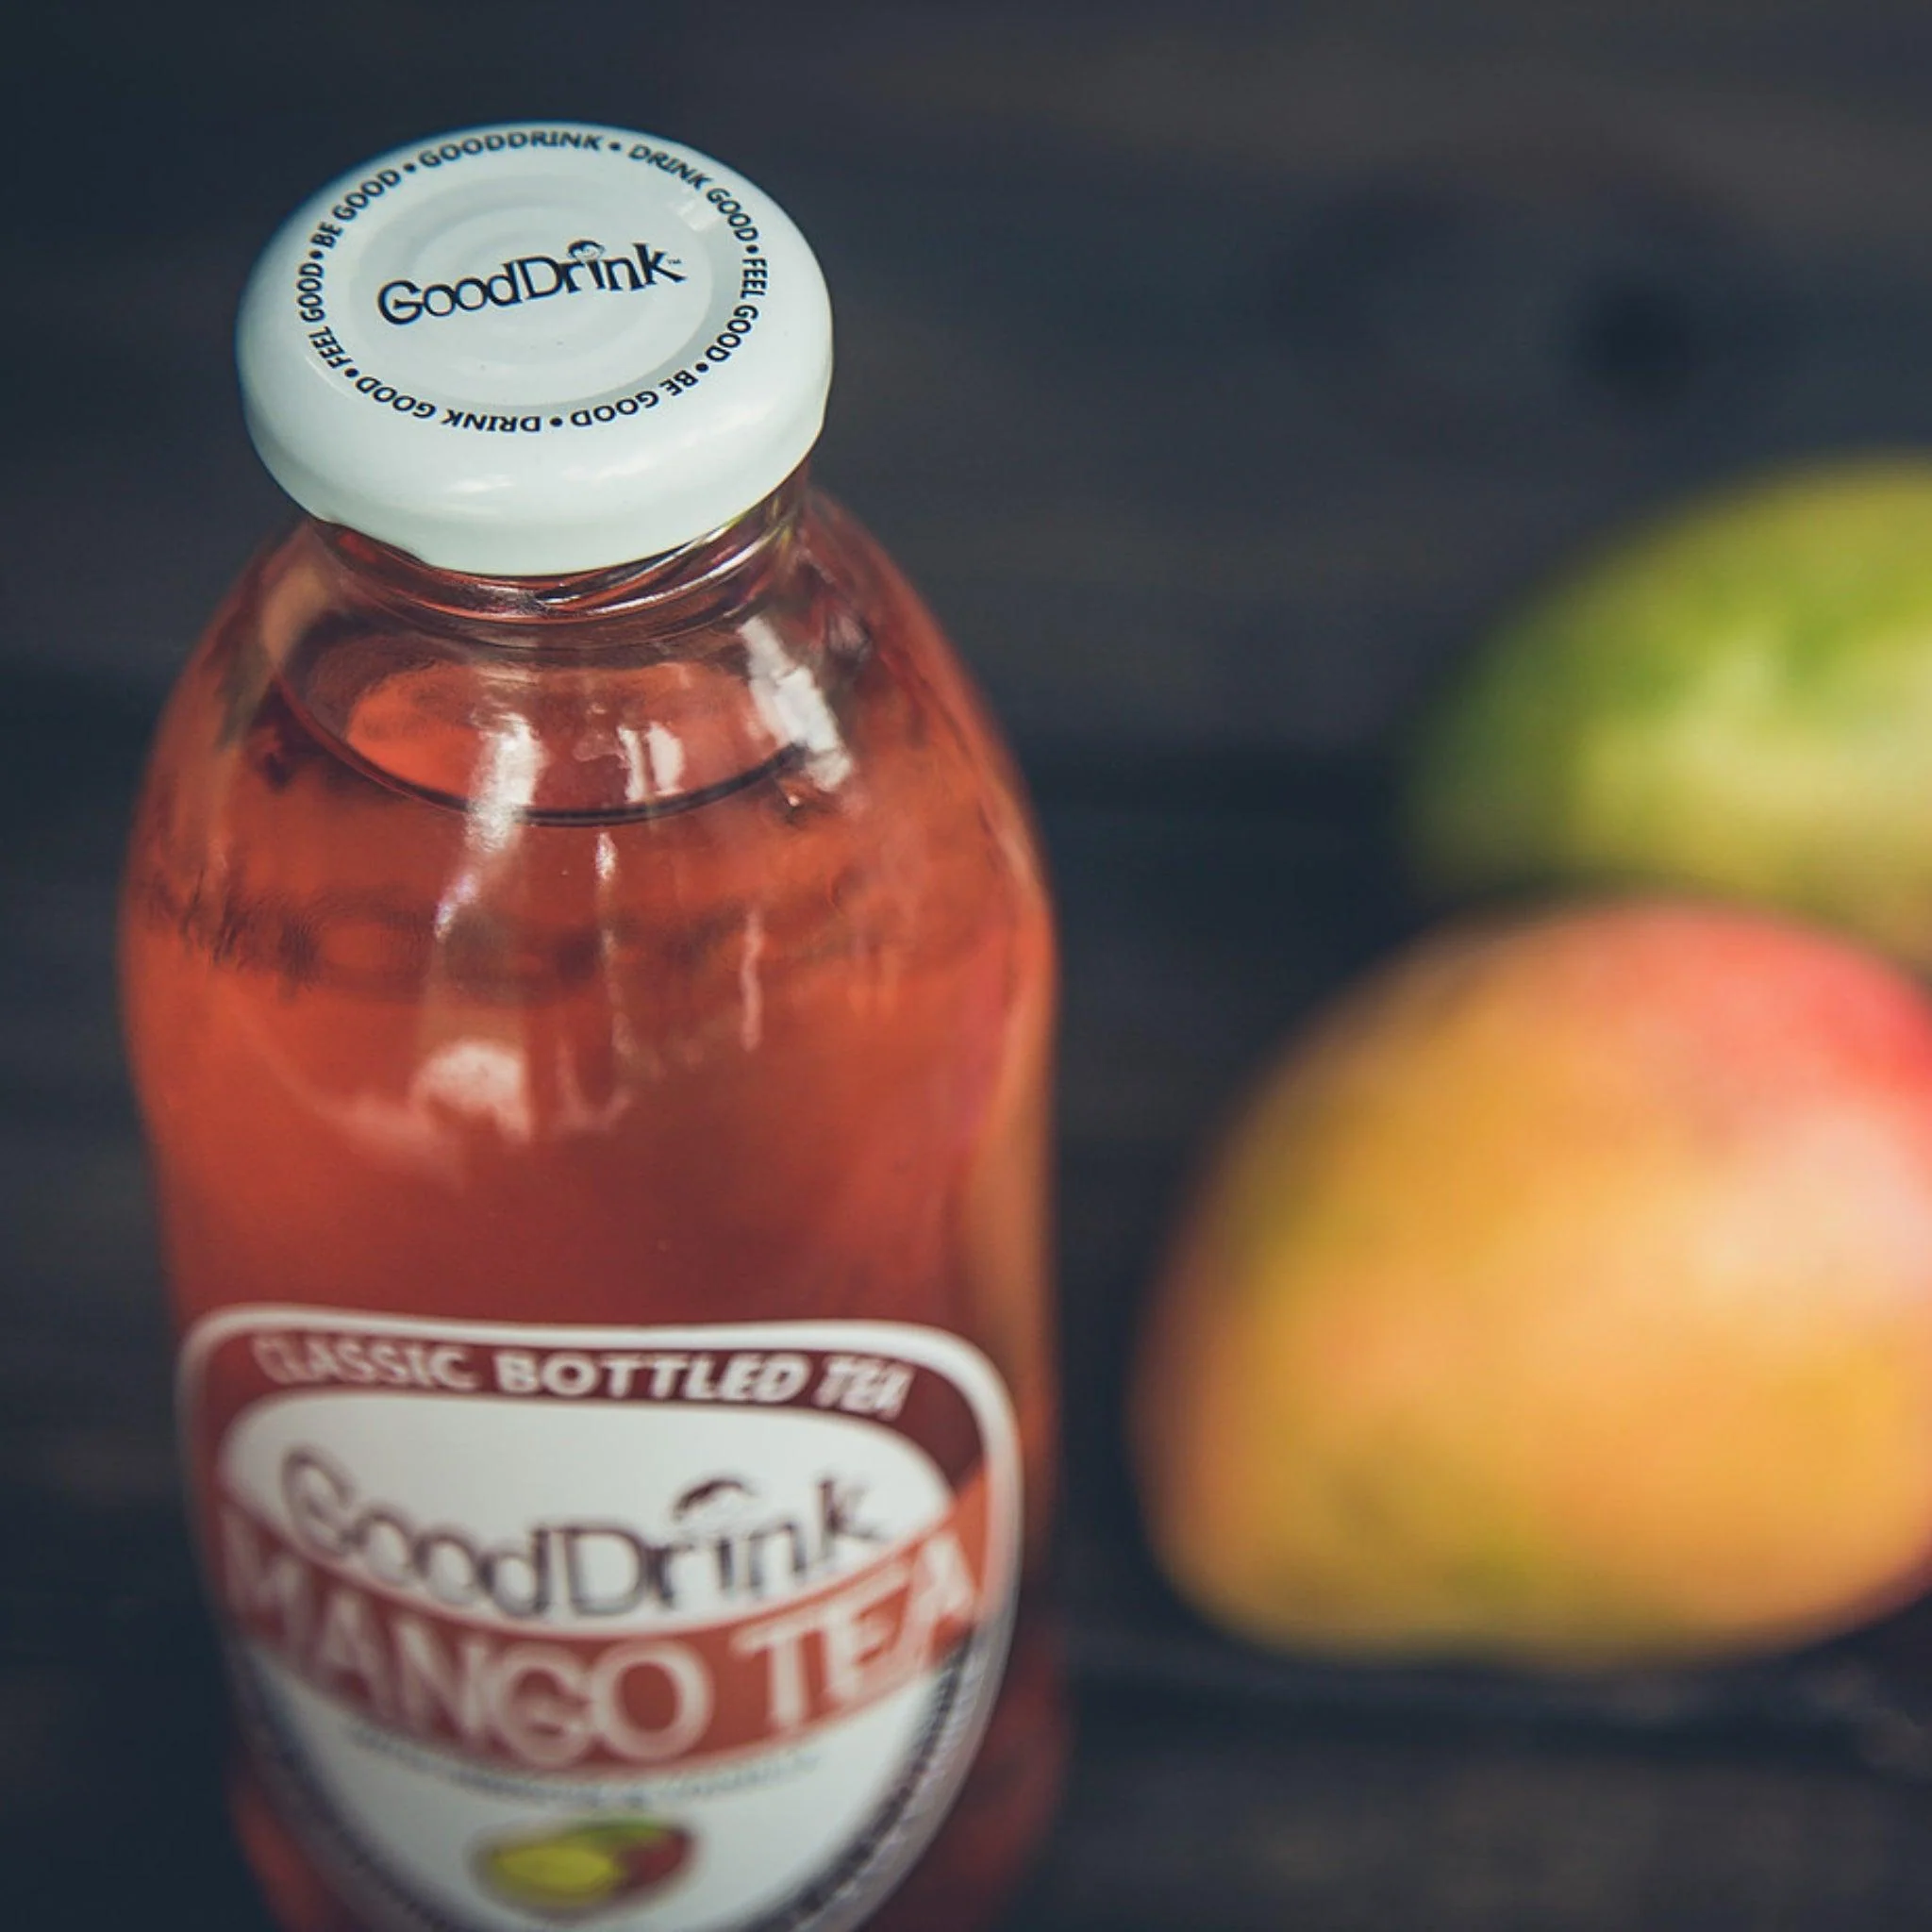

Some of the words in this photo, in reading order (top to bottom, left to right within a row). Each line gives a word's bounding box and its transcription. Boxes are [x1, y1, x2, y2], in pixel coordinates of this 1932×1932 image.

[418, 130, 603, 168] GOODDRINK
[310, 221, 343, 249] BE
[333, 169, 402, 222] GOOD
[628, 144, 711, 190] DRINK
[707, 188, 758, 242] GOOD
[295, 261, 325, 323] GOOD
[377, 242, 687, 325] GoodDrink
[740, 258, 768, 300] FEEL
[308, 326, 354, 369] FEEL
[705, 304, 758, 363] GOOD
[355, 375, 436, 419] GOOD
[571, 390, 659, 427] GOOD
[659, 369, 699, 396] BE
[441, 408, 541, 433] DRINK
[251, 1333, 477, 1391] CLASSIC
[494, 1351, 810, 1403] BOTTLED
[281, 1447, 885, 1620] GoodDrink
[221, 1511, 713, 1767] MANGO
[730, 1530, 975, 1730] TEA
